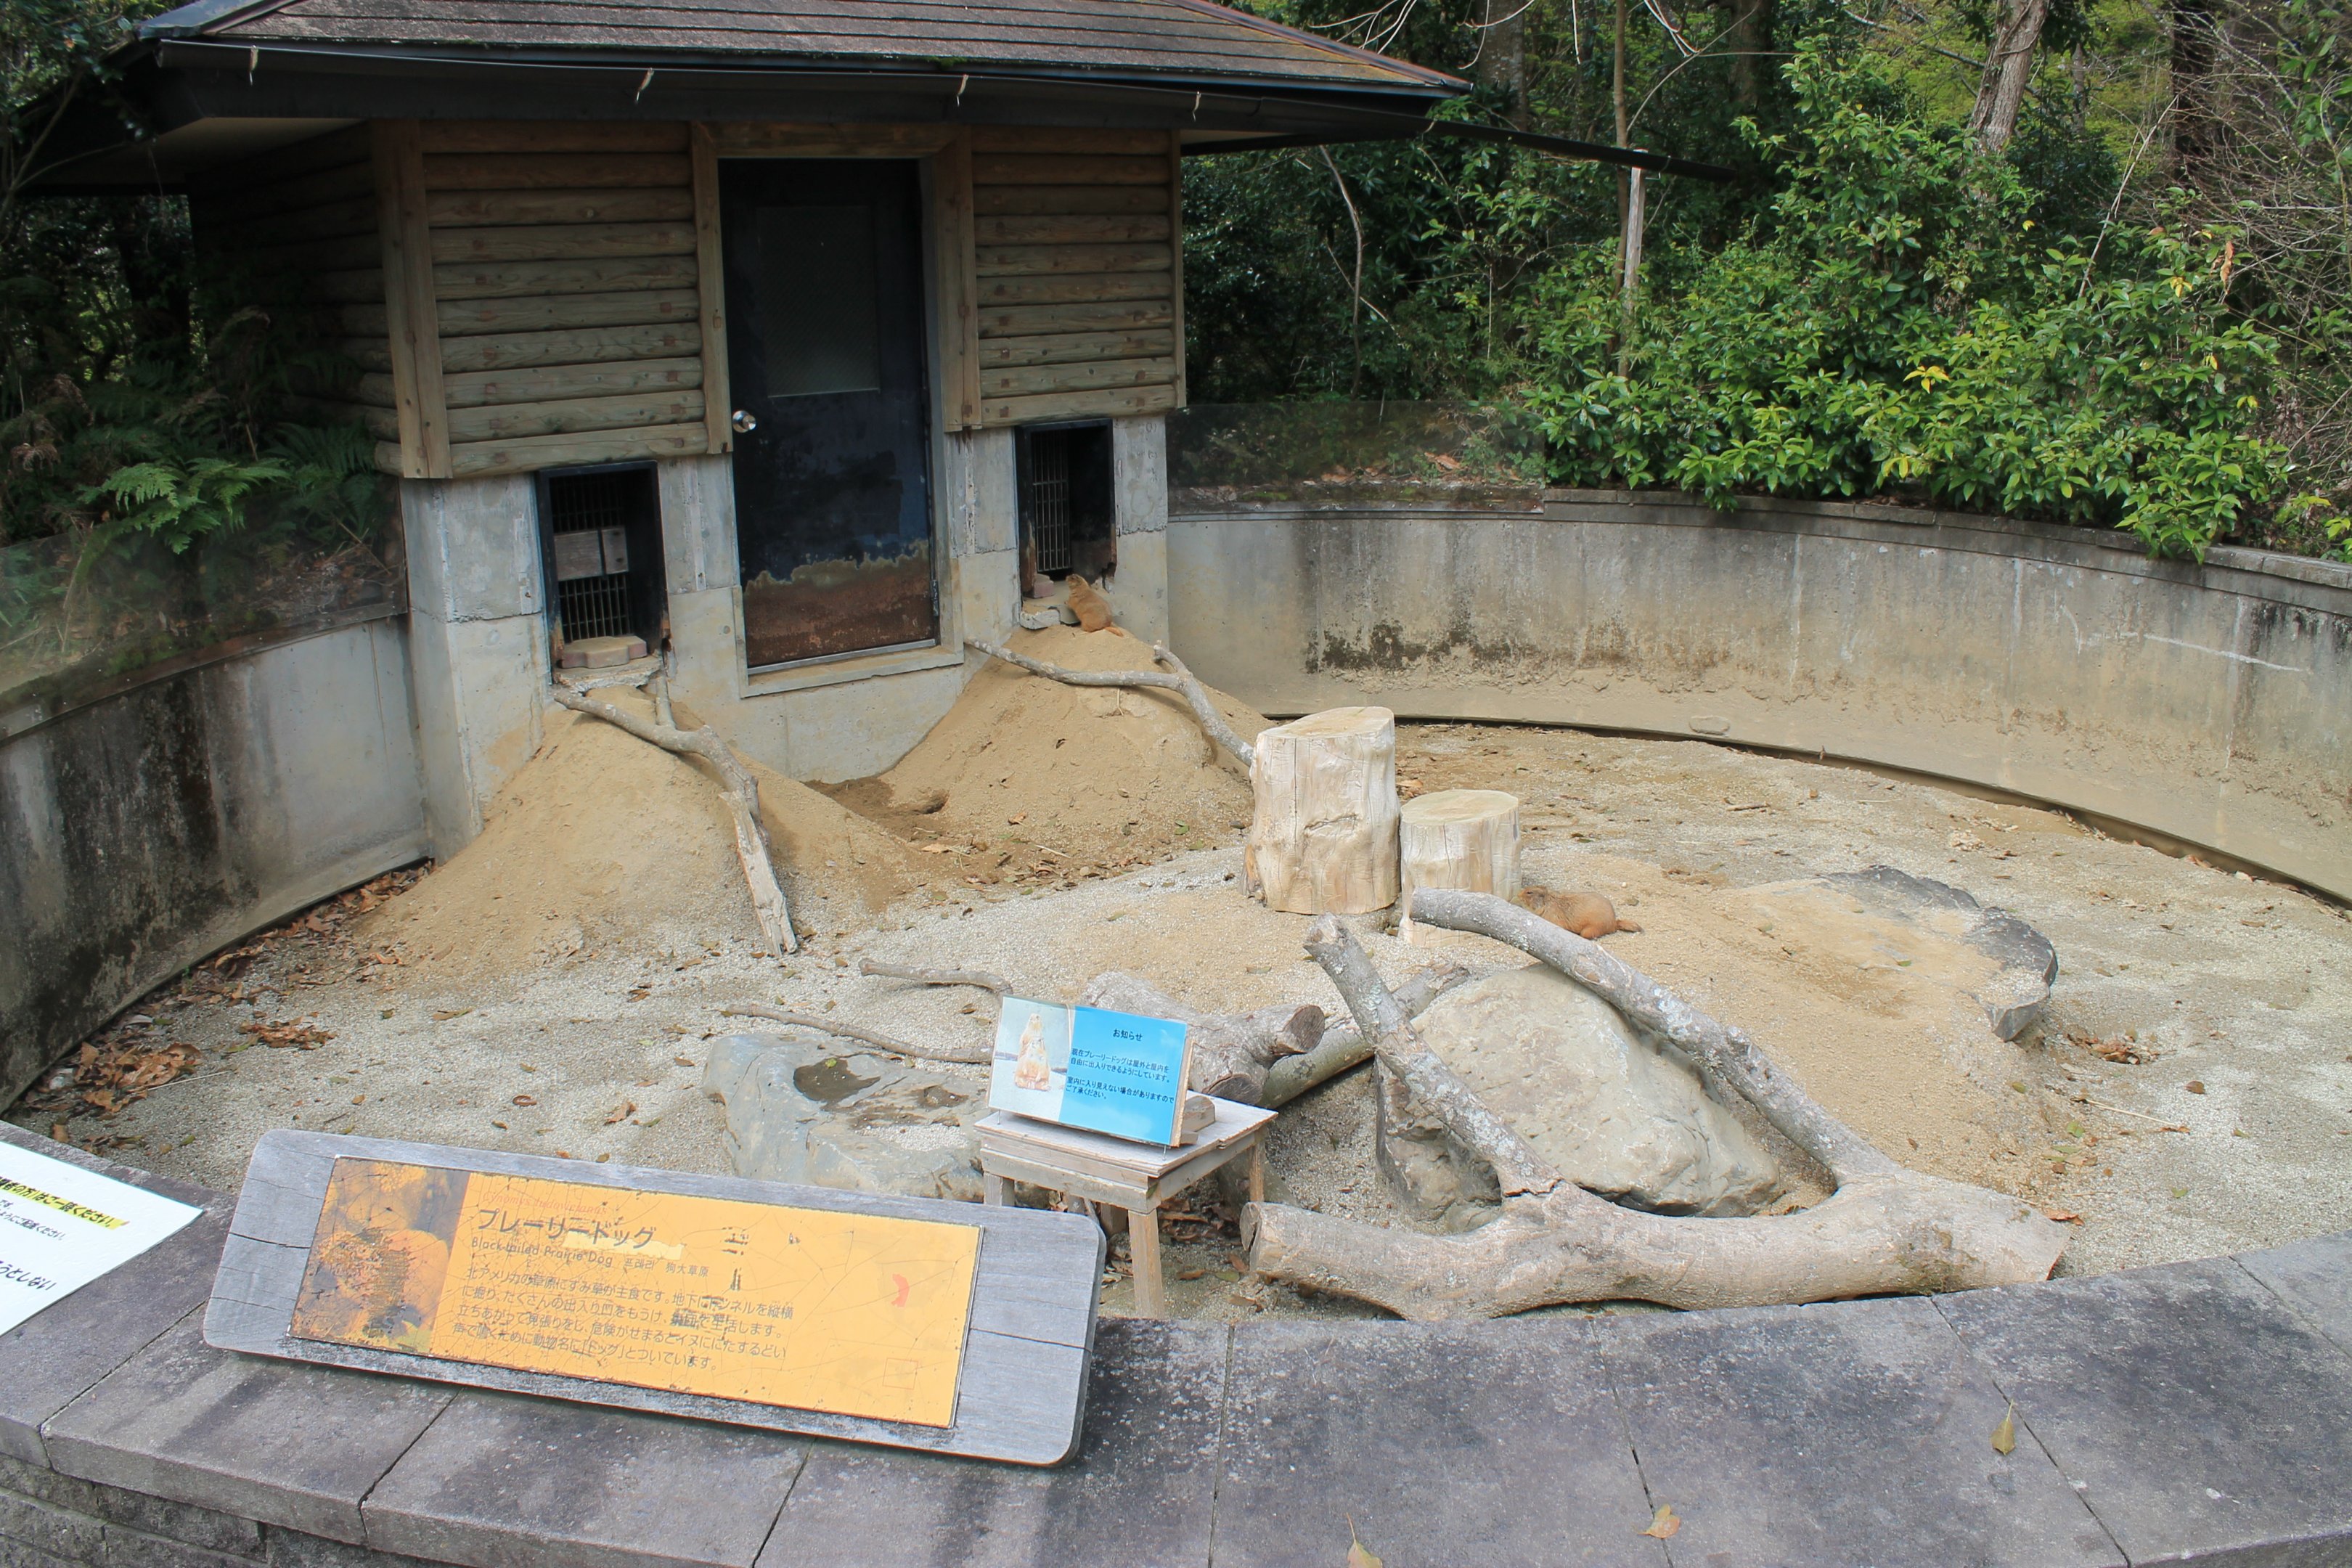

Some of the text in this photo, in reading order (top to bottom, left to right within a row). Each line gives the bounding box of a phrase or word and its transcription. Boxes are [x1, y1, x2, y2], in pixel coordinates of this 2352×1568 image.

[1112, 1028, 1143, 1042] お知らせ
[1070, 1058, 1170, 1083] 自由に出入りできるようにしています。
[1071, 1048, 1169, 1073] 現在プレーリードッグは屋外と屋内を
[1066, 1085, 1107, 1100] ご了承ください。
[1067, 1076, 1175, 1104] 室内に入り見えない場合がありますので
[482, 1192, 530, 1206] Cynomys
[478, 1207, 657, 1249] プレーリードッグ
[472, 1236, 613, 1267] Black-tailed Prairie Dog
[0, 1261, 57, 1291] うとしない
